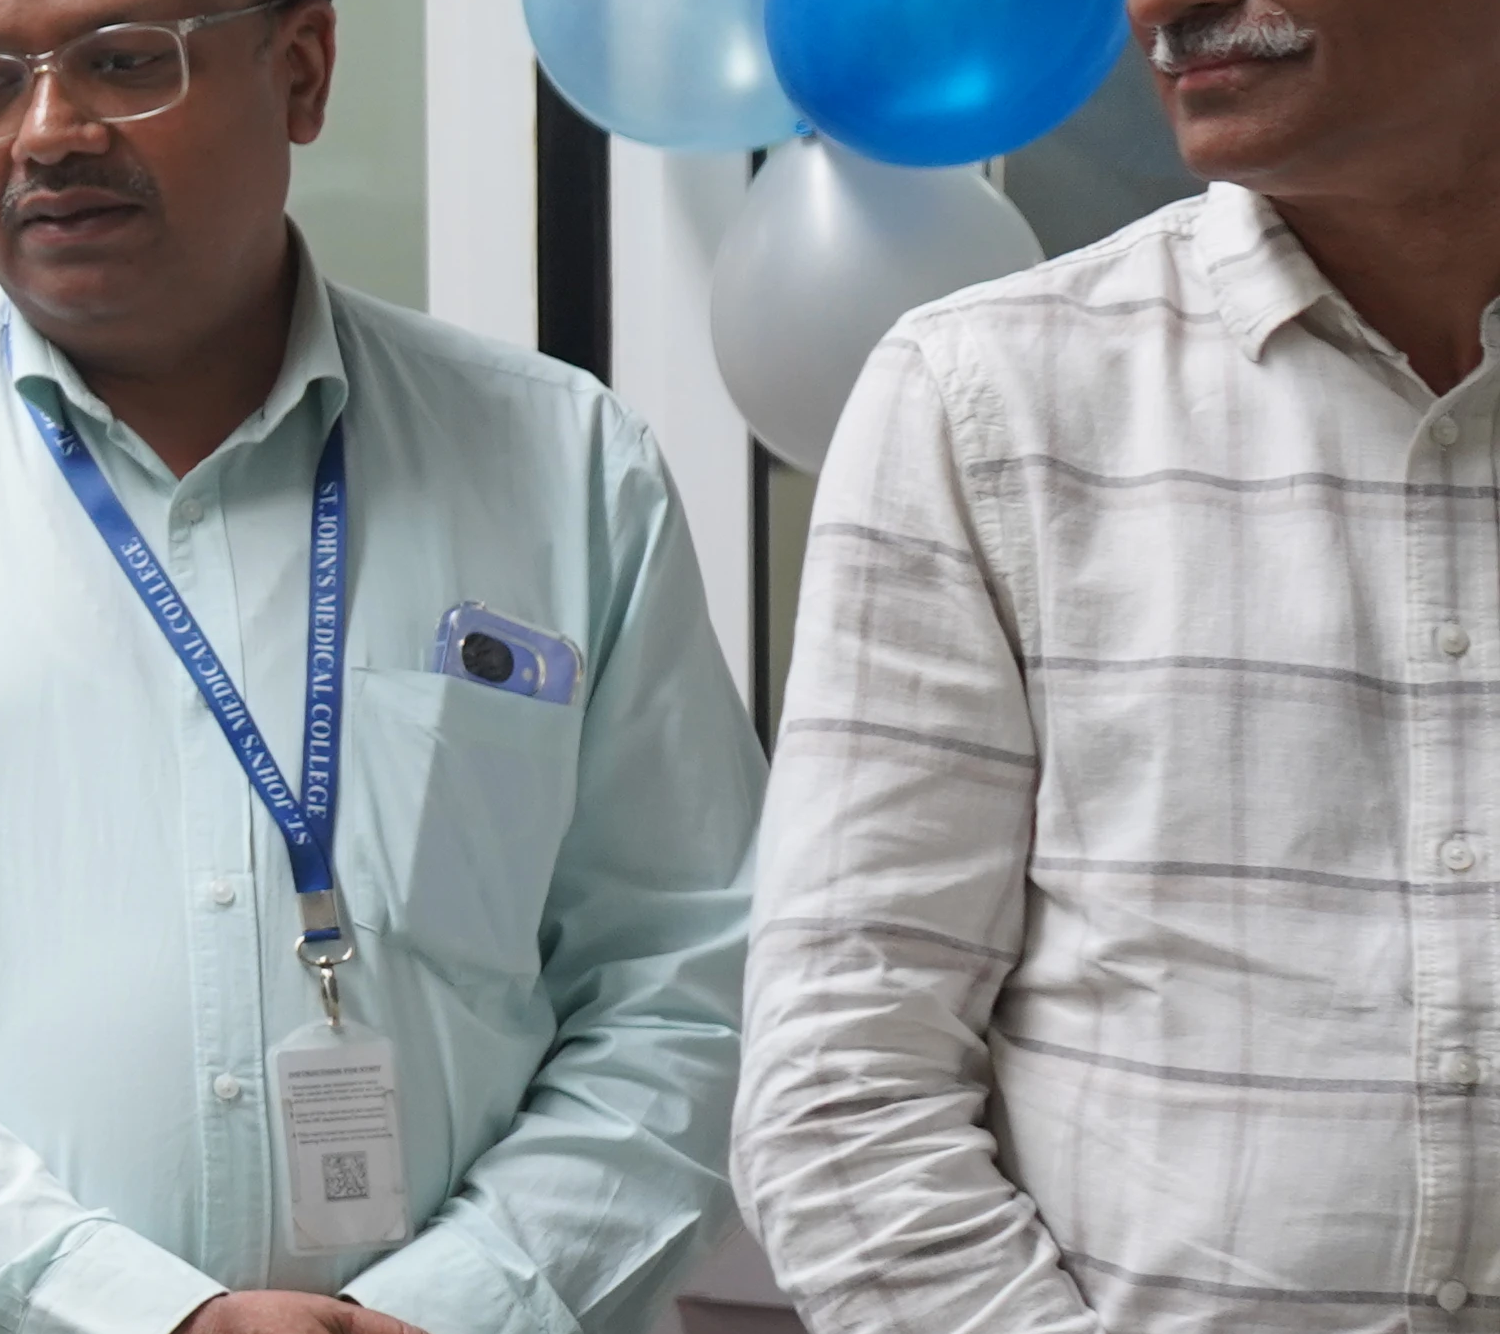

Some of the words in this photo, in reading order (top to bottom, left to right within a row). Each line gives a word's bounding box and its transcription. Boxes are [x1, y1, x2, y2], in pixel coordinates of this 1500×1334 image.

[120, 536, 192, 634] COLLEGE
[315, 511, 338, 588] JOHN'S
[183, 630, 251, 732] MEDICAL
[312, 590, 337, 699] MEDICAL
[239, 733, 296, 810] JOHN'S
[306, 703, 334, 819] COLLEGE
